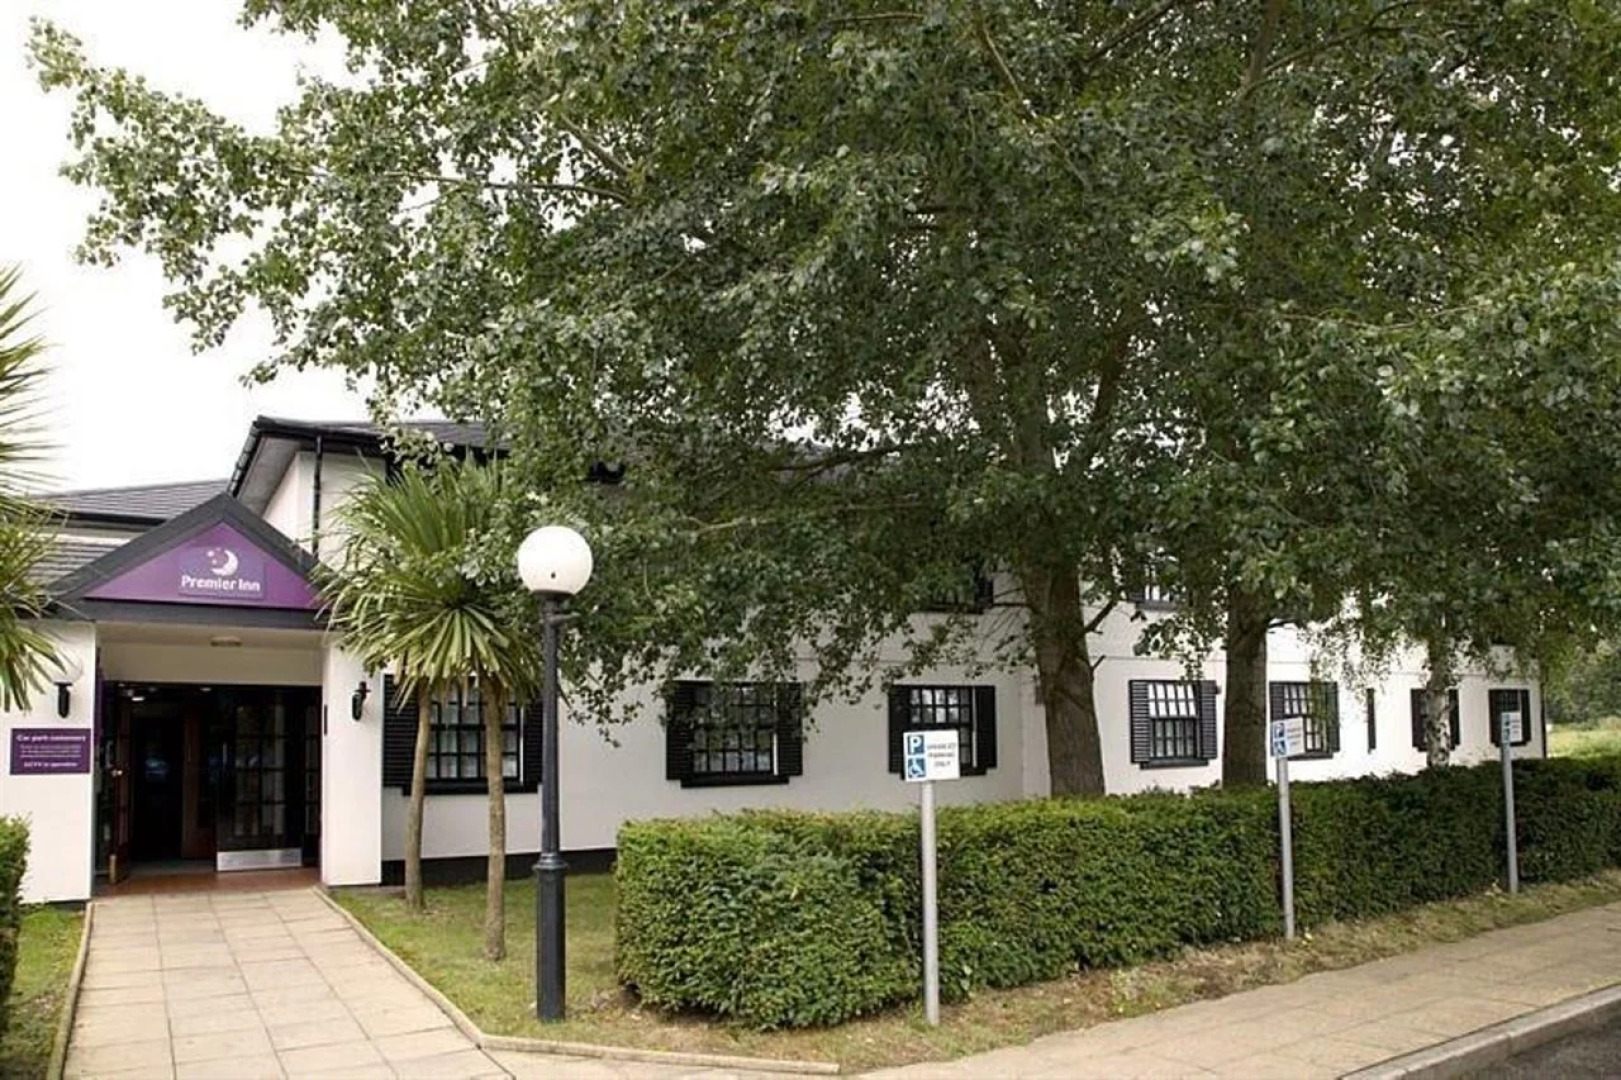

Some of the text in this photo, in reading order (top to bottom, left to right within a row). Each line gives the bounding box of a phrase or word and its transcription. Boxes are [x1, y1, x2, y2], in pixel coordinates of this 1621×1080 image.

[181, 574, 261, 591] Premier Inn
[910, 736, 922, 753] P
